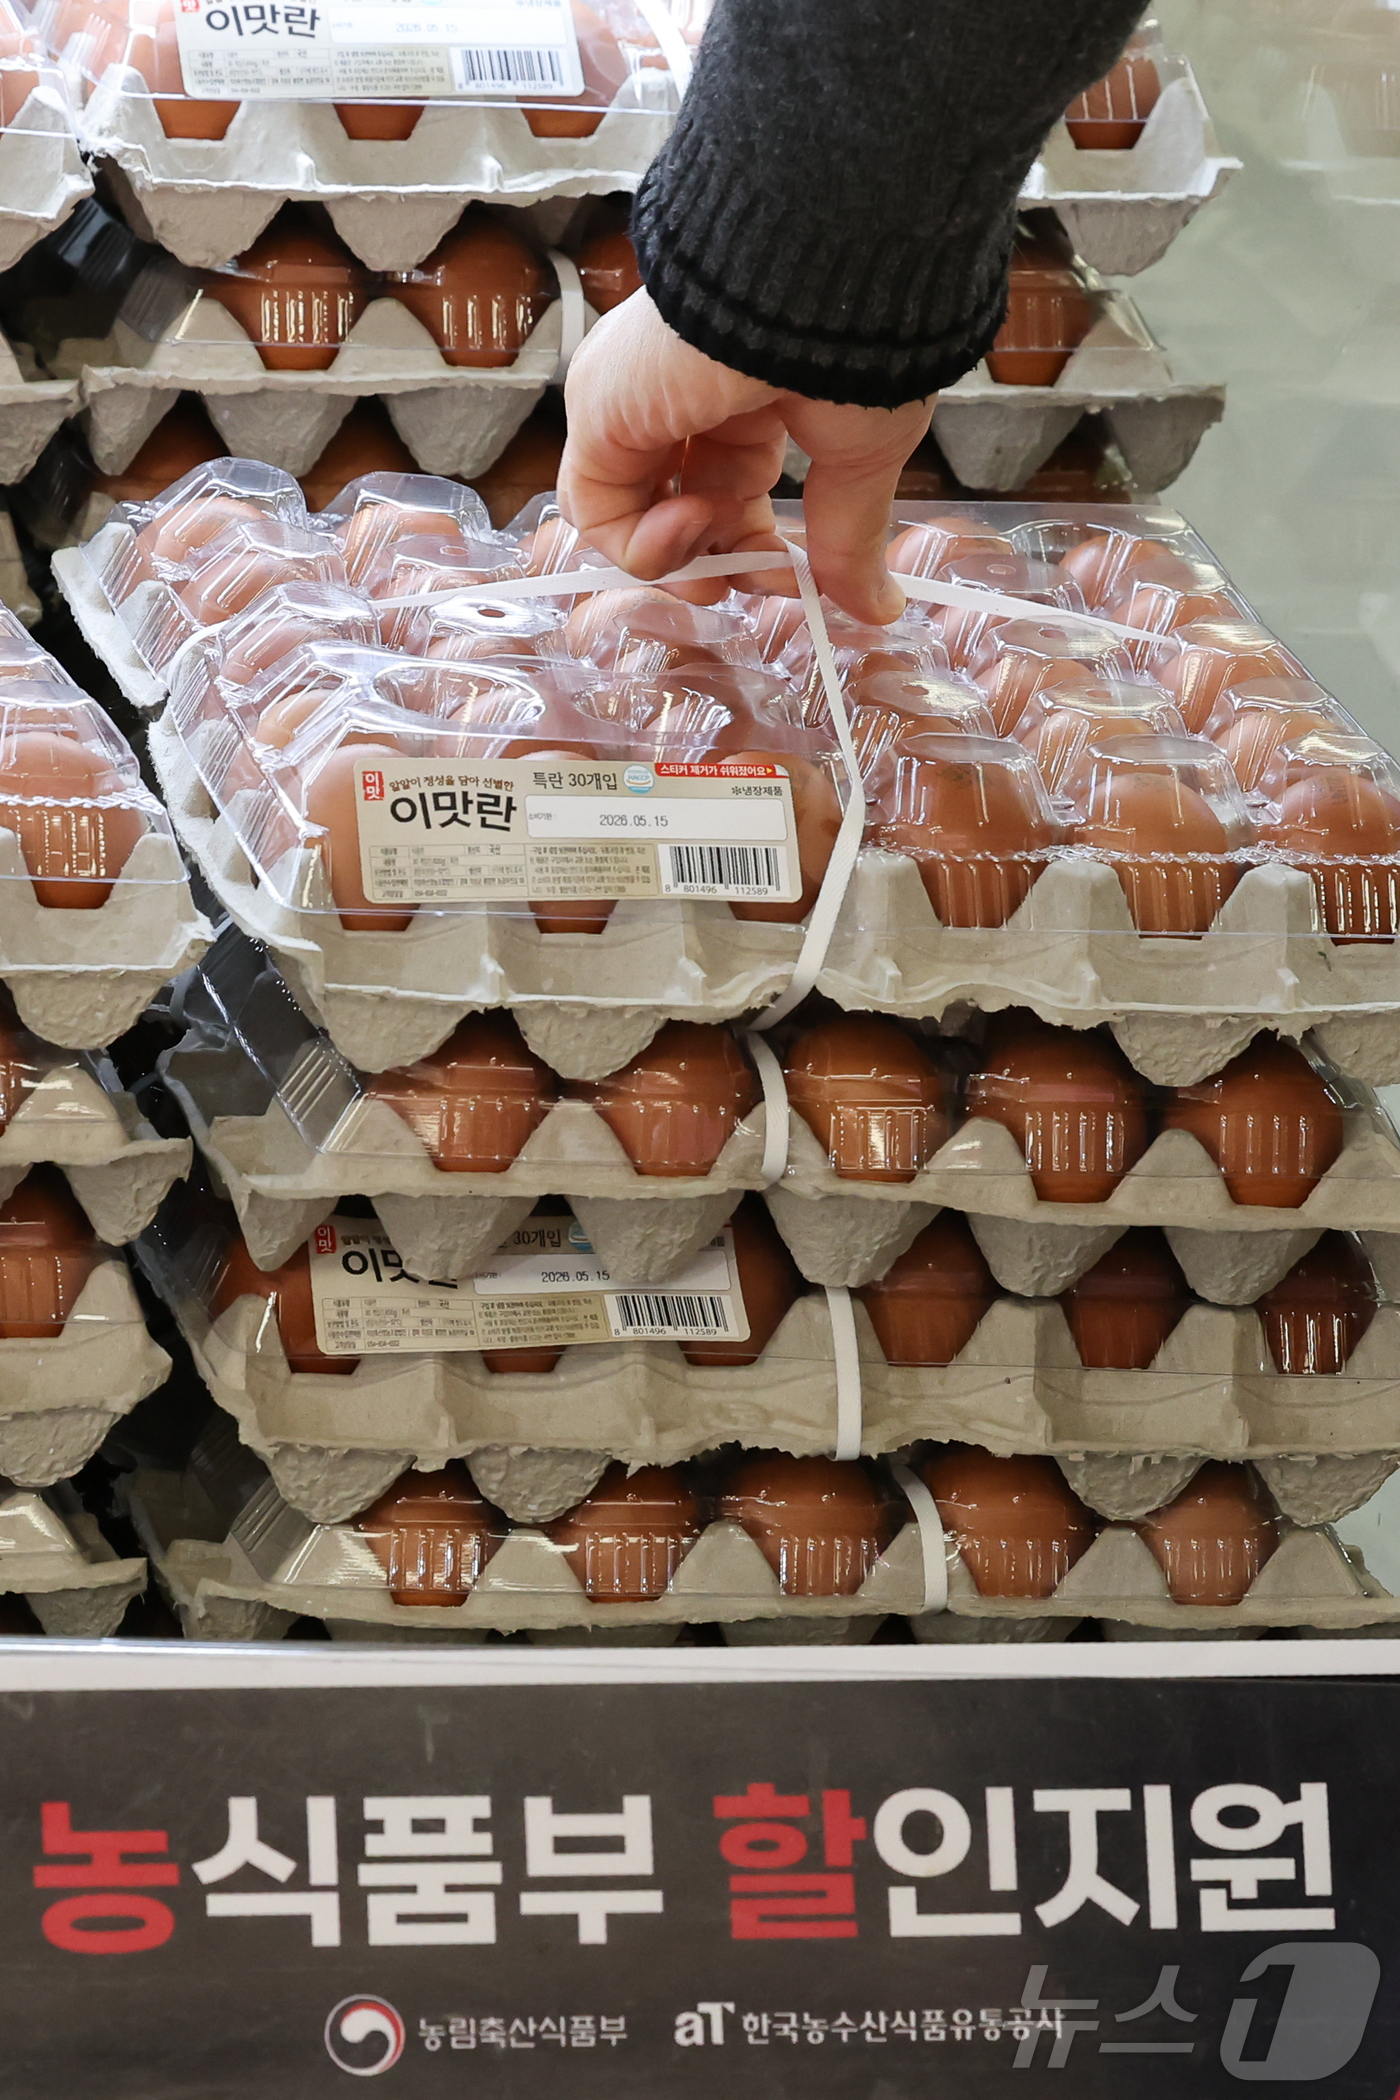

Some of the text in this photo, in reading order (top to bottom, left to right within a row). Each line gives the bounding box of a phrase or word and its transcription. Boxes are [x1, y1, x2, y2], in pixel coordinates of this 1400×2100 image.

[205, 4, 320, 39] 이맛란
[533, 772, 618, 791] 특란 30개입
[660, 764, 767, 777] 스티커 제거가 쉬워졌어요
[365, 772, 380, 800] 이맛
[458, 775, 480, 787] 담아
[482, 777, 514, 793] 선별한
[390, 790, 518, 833] 이맛란
[599, 814, 669, 828] 2026.05.15
[664, 884, 769, 896] 8 801496 112589
[317, 1226, 332, 1253] 이맛
[513, 1228, 562, 1248] 30개입
[541, 1270, 610, 1283] 2026.05.15
[614, 1327, 717, 1336] 8 801496 112589
[33, 1783, 1335, 1954] 농식품부 할인지원
[418, 2015, 627, 2052] 농림축산식품부
[674, 2002, 735, 2047] aT
[742, 2008, 1066, 2046] 한국농수산식품유통공사
